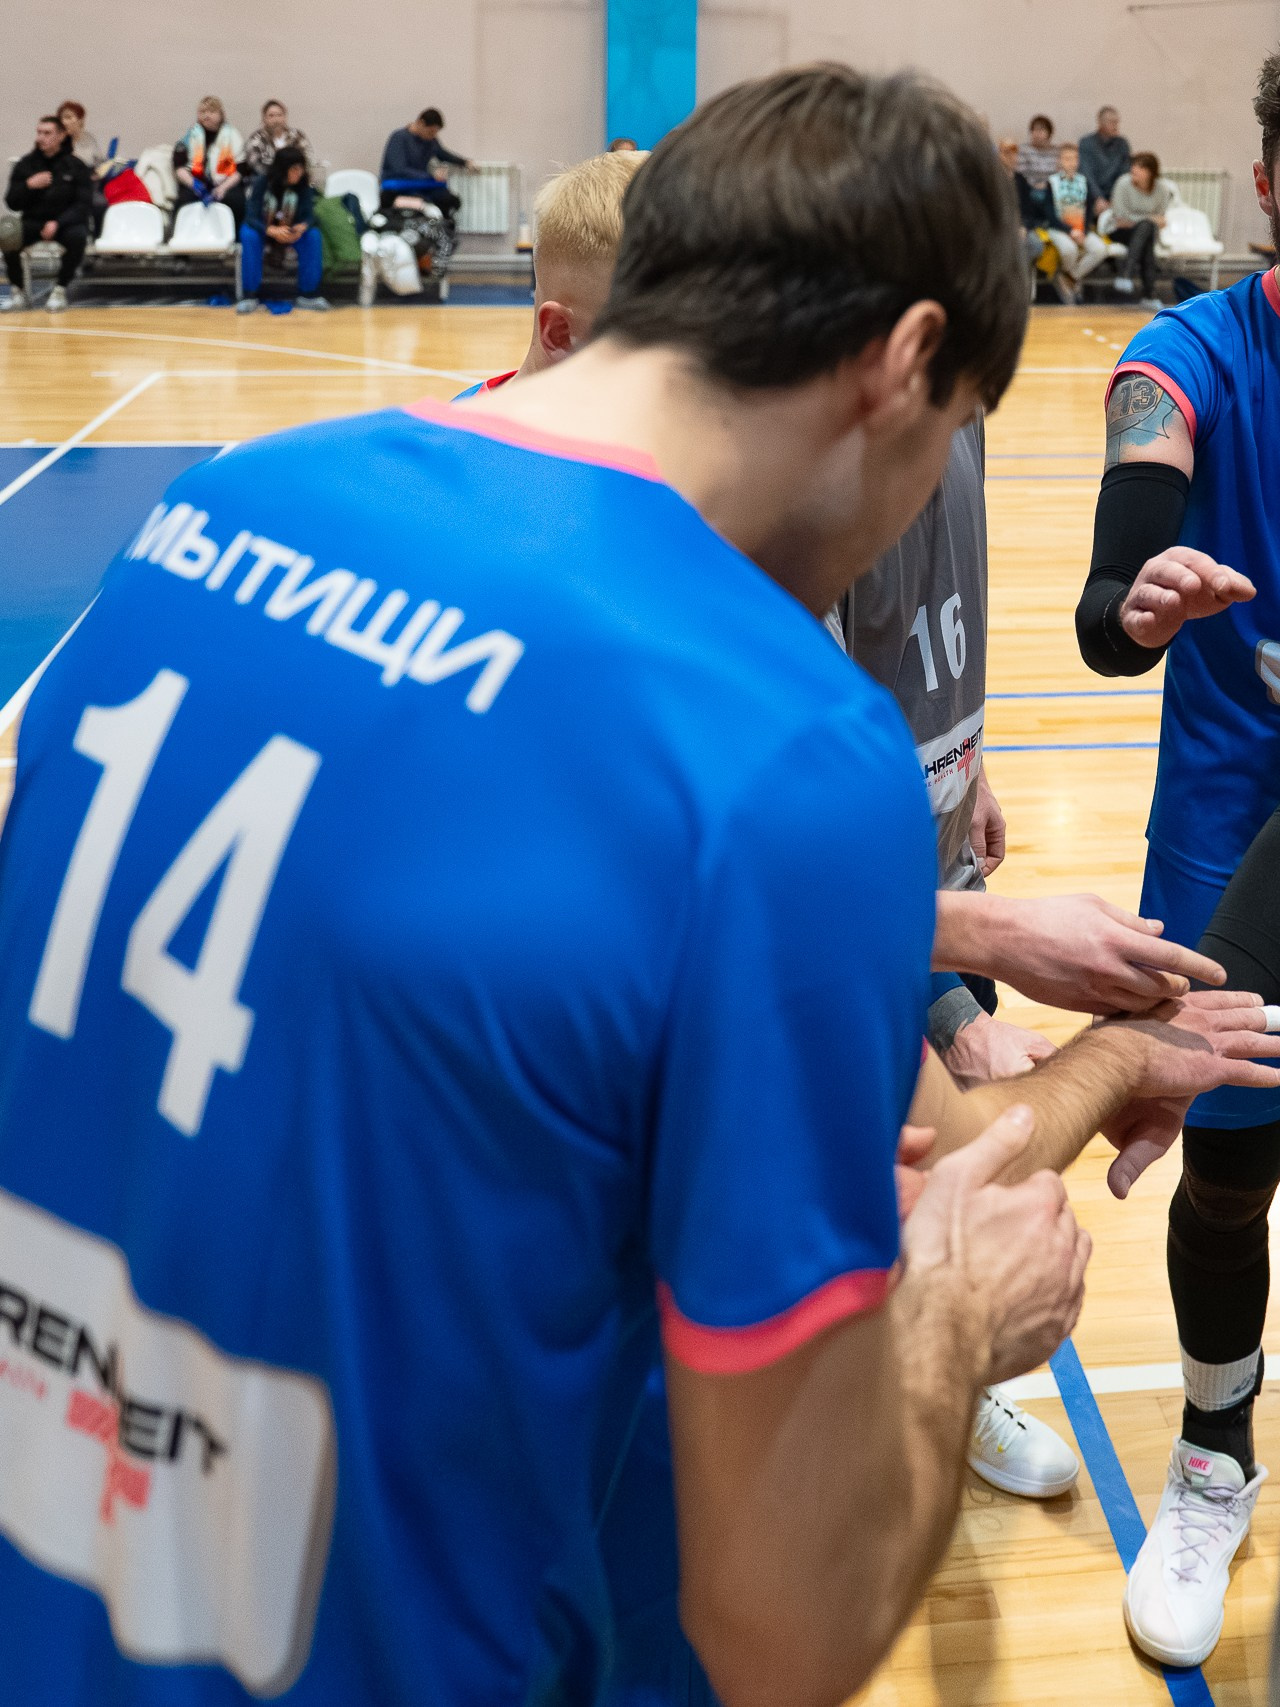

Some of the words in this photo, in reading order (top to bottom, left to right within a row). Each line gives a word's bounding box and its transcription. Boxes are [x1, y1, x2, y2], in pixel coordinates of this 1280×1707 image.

[125, 501, 525, 714] МЫТИЩИ
[906, 592, 967, 693] 16
[27, 668, 323, 1138] 14
[1188, 1456, 1210, 1471] NIKE
